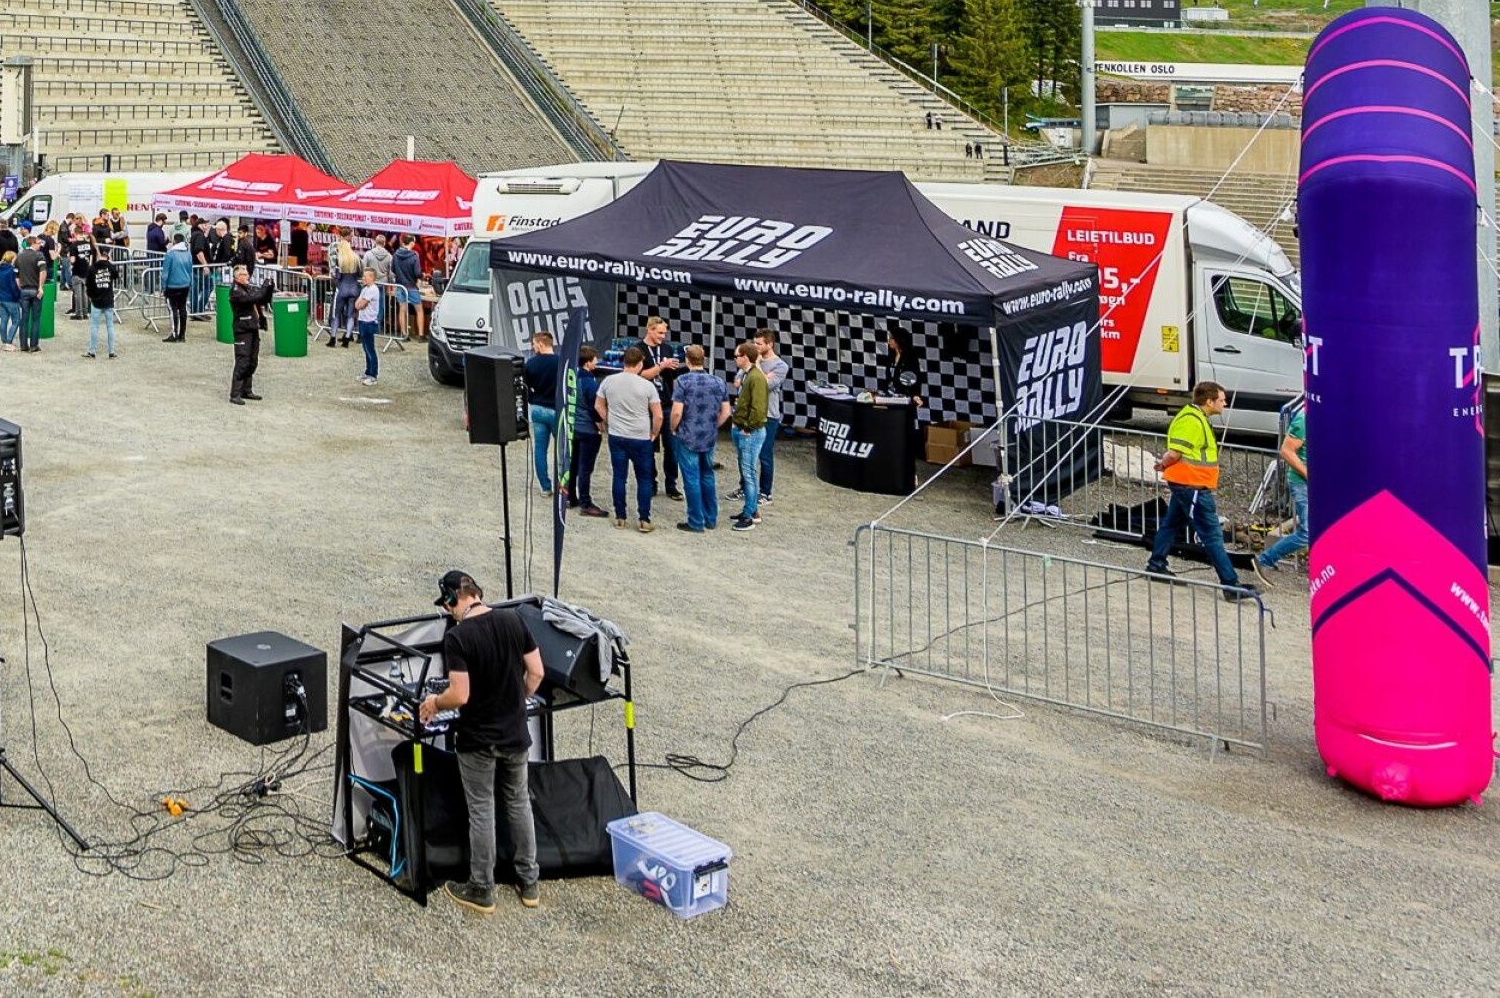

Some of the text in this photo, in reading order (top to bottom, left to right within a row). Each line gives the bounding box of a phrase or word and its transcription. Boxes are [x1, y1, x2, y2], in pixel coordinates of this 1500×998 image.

[1096, 63, 1175, 74] ENKOLLEN OSLO
[509, 215, 561, 228] Finstad
[675, 215, 833, 249] EURO
[1067, 229, 1155, 245] LEIETILBUD
[507, 251, 691, 284] www.euro-rally.com
[642, 238, 802, 269] RALLY
[1068, 251, 1090, 263] Fra
[1099, 267, 1141, 292] 5,-
[734, 277, 965, 314] www.euro-rally.com
[1002, 277, 1092, 315] www.euro-rally.com
[1017, 320, 1087, 384] EURO
[1014, 367, 1084, 434] RALLY
[819, 417, 850, 439] EURO
[824, 436, 874, 458] RALLY
